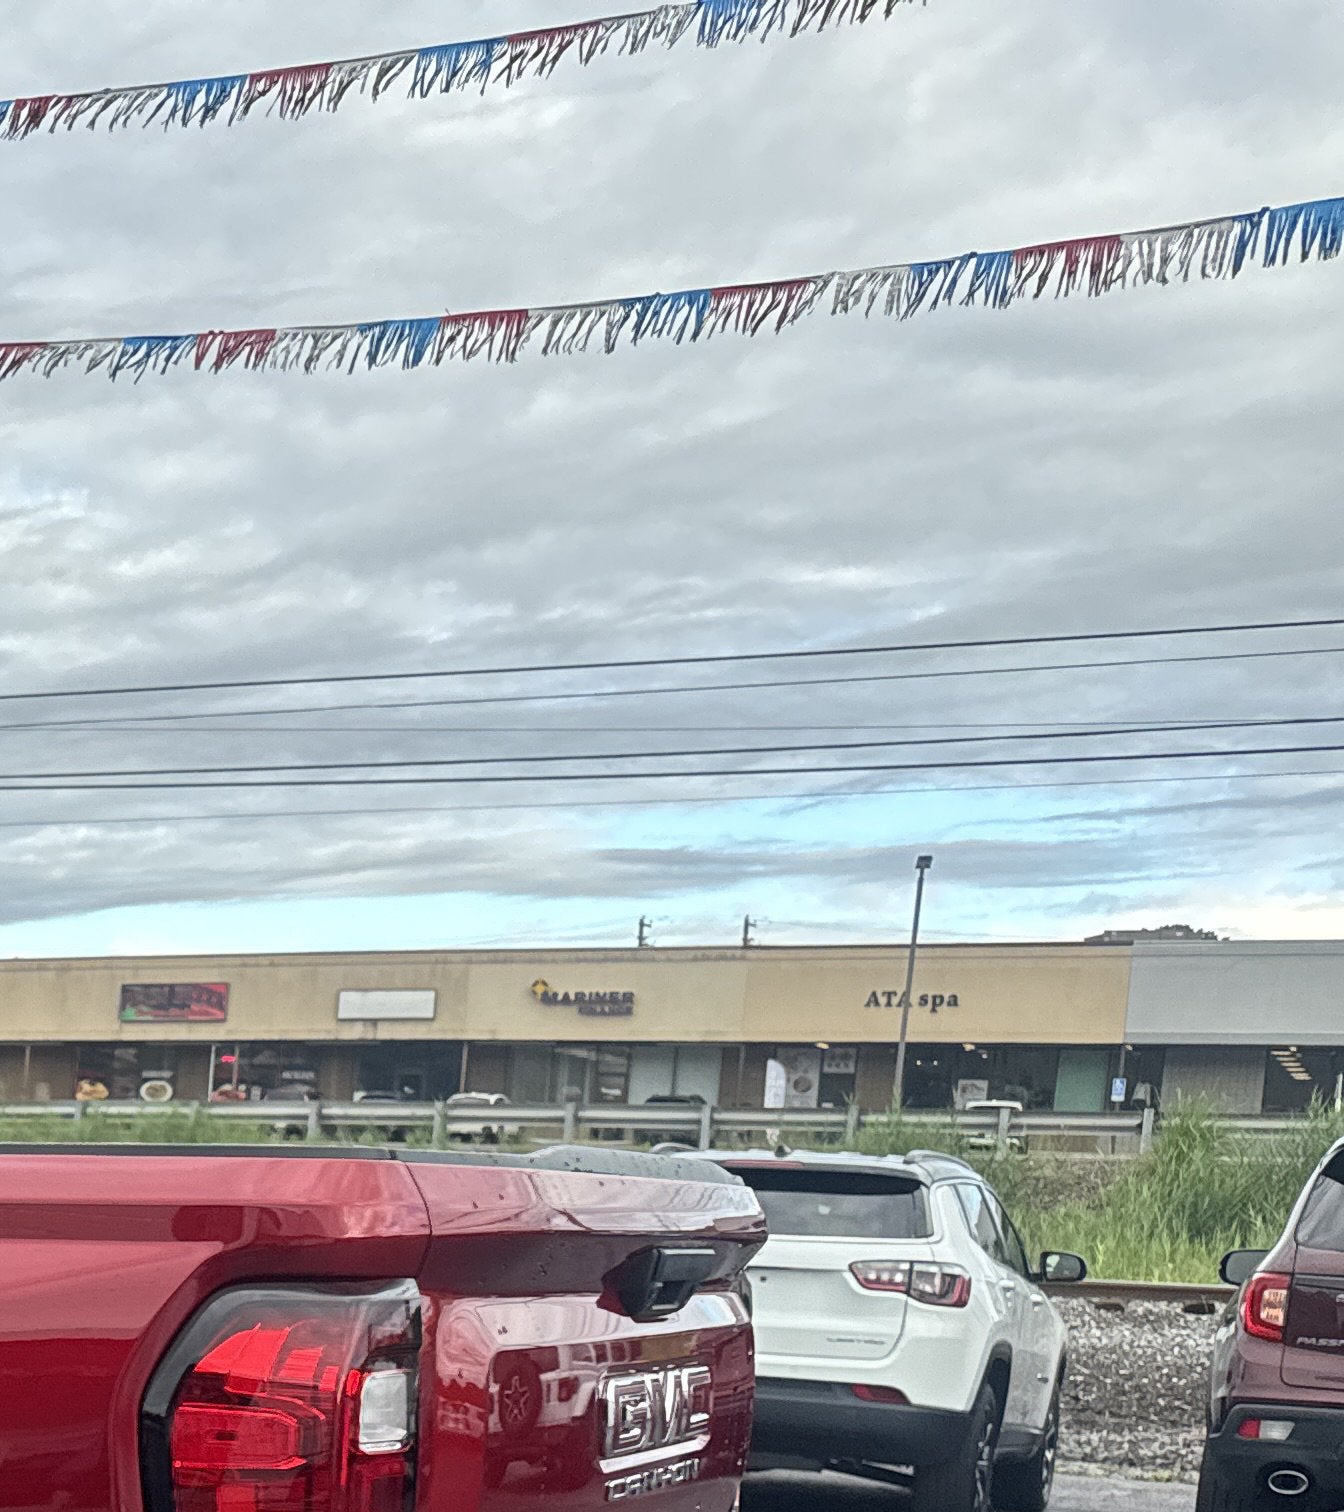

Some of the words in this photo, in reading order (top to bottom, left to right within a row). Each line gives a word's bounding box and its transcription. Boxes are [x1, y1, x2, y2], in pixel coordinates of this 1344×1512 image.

[540, 991, 635, 1006] MARINER
[918, 993, 960, 1014] spa
[603, 1366, 711, 1455] GMC
